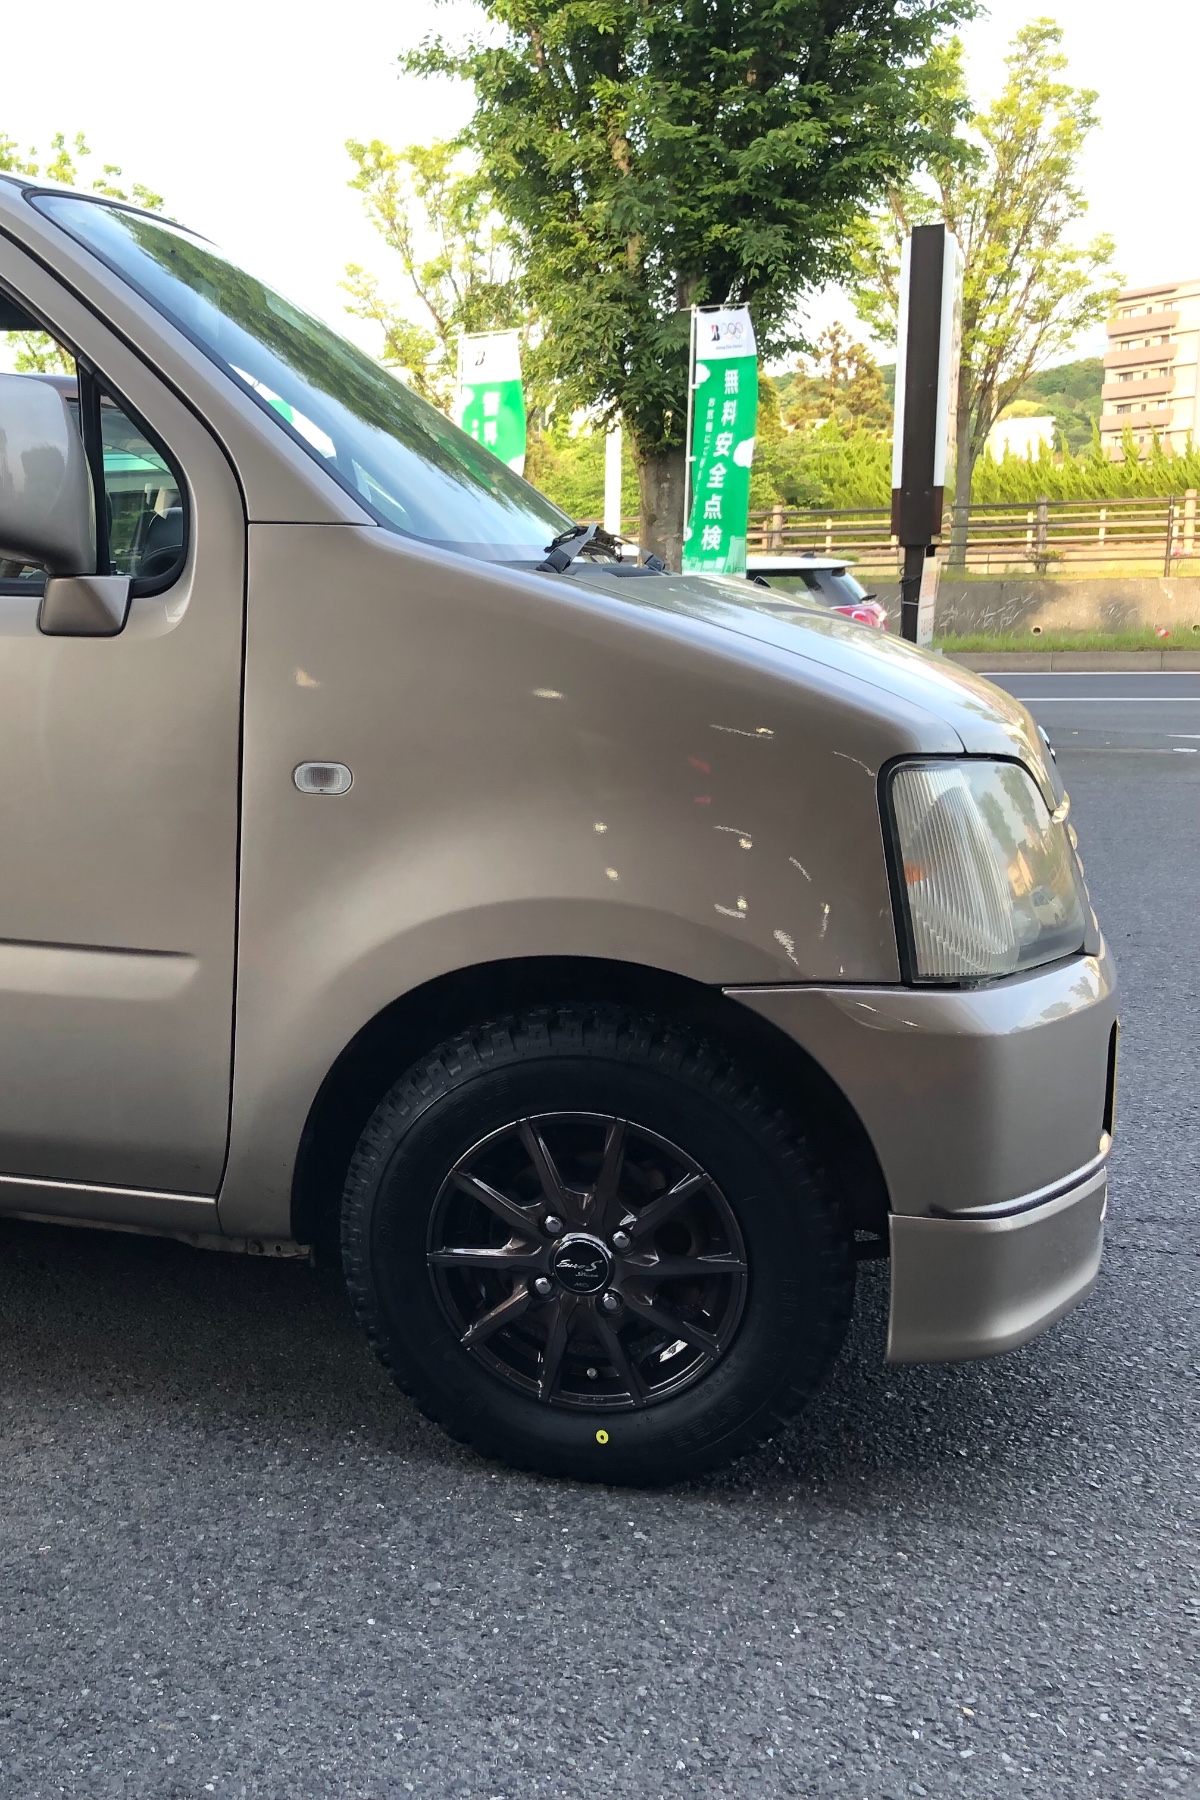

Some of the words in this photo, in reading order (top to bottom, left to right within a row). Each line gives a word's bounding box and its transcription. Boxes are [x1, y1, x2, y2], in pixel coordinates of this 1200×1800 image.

[700, 368, 740, 552] 無料安全点検
